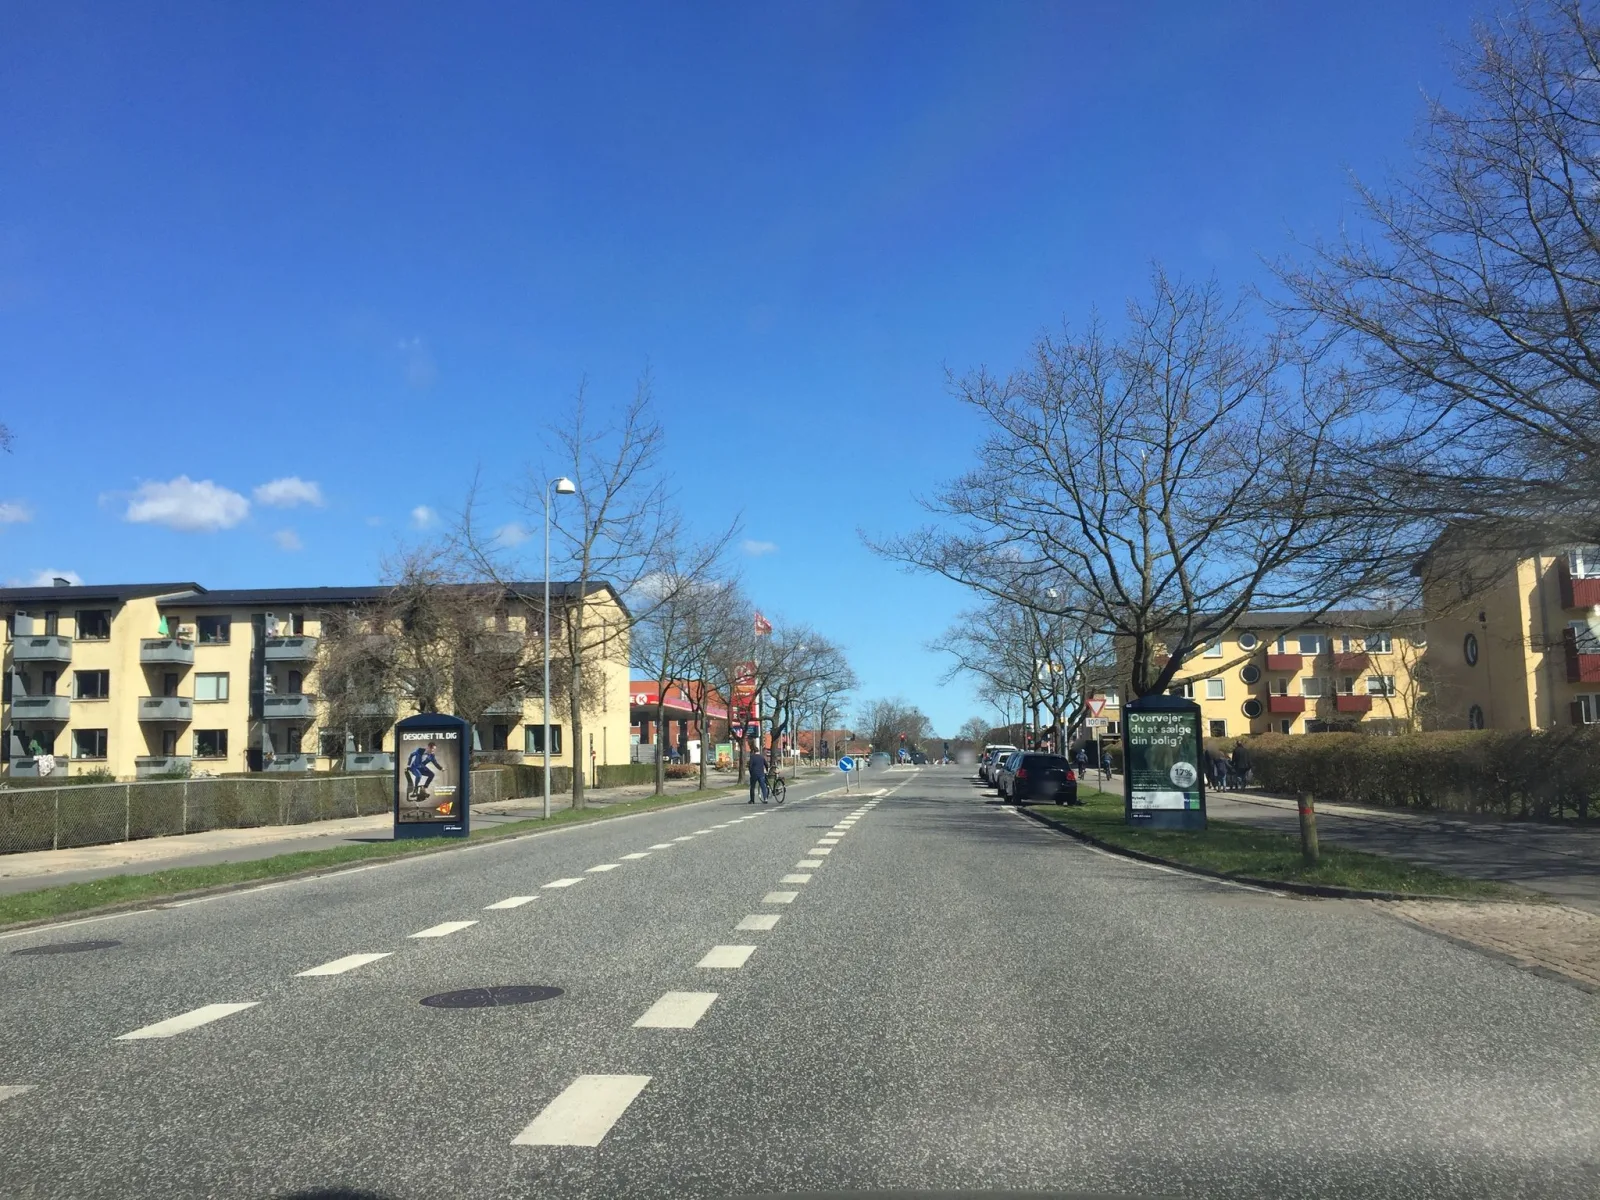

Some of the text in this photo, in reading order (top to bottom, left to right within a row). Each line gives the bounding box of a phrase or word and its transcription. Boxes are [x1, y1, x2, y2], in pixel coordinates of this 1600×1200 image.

[1088, 718, 1099, 726] 100
[1130, 713, 1183, 724] Overvejer
[1130, 724, 1191, 736] du at sælge
[403, 732, 457, 741] DESIGNET TIL DIG
[1131, 735, 1183, 747] din bolig?
[1174, 768, 1193, 777] 17%
